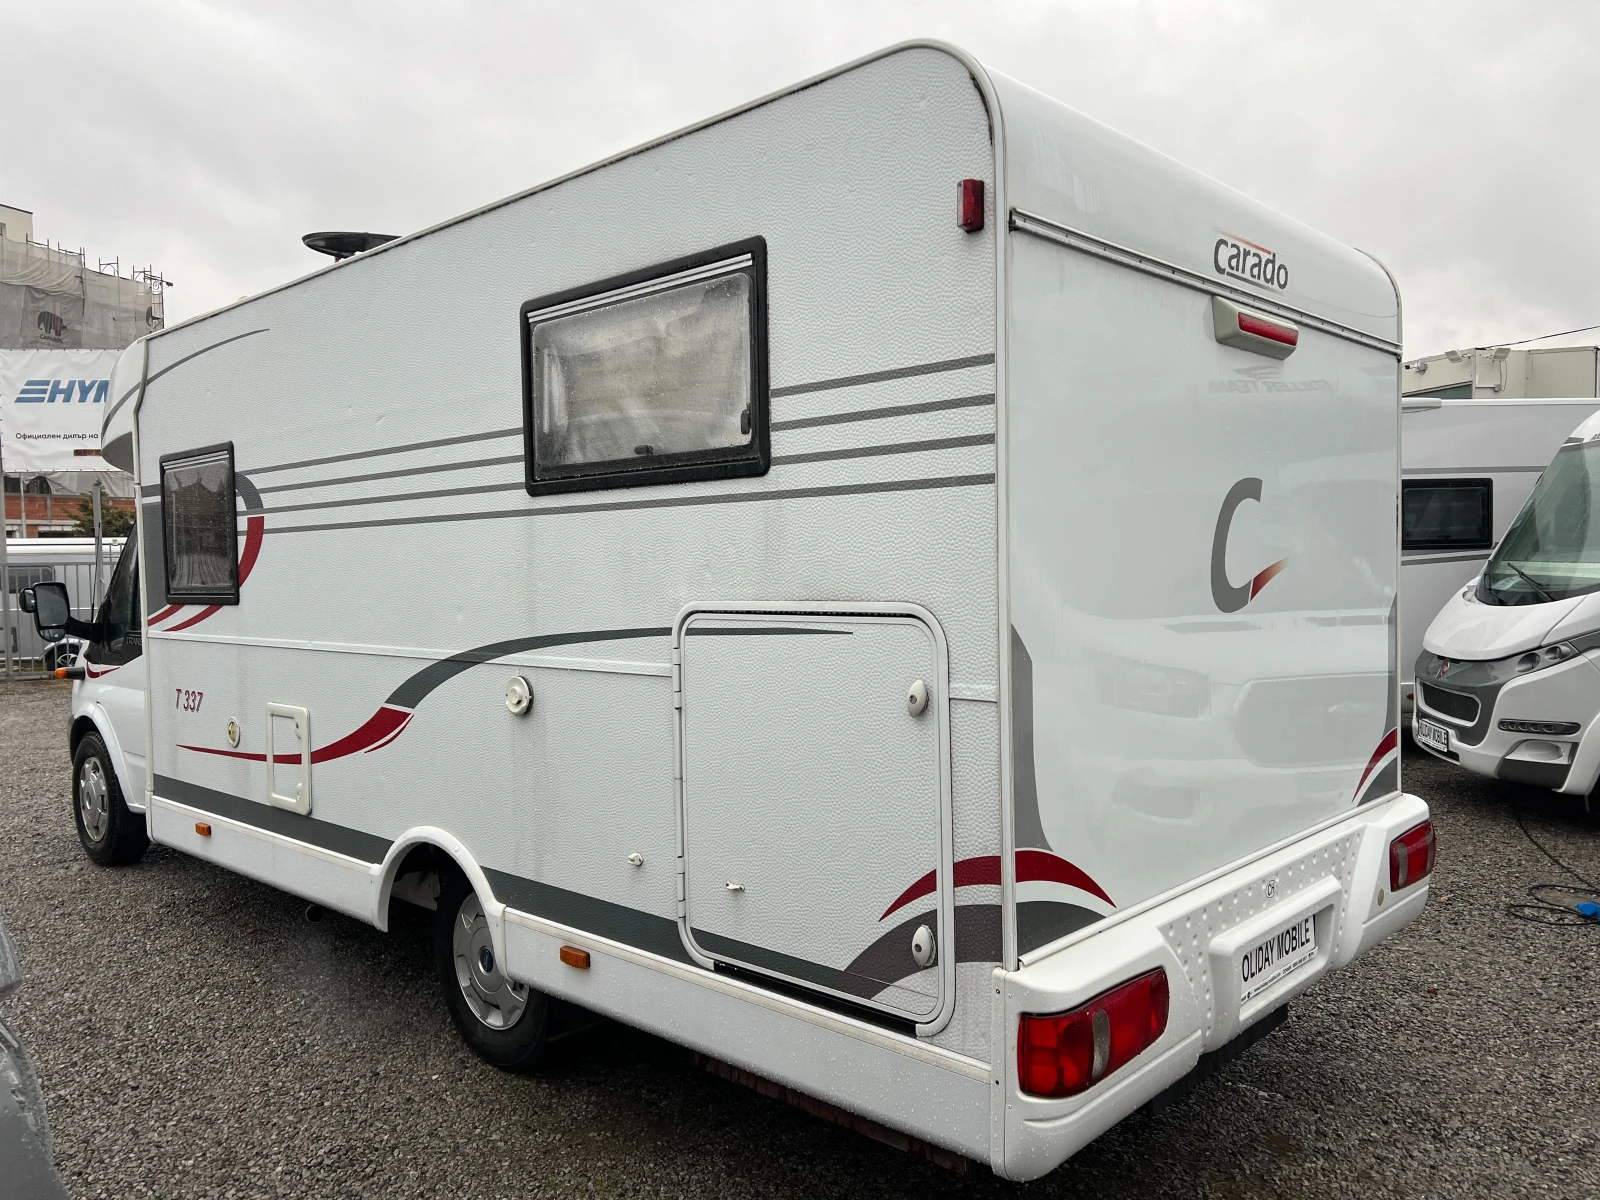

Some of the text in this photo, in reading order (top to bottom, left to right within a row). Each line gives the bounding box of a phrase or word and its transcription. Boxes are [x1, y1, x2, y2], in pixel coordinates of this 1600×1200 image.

[15, 432, 61, 440] Официален
[176, 689, 204, 713] T 337
[1242, 937, 1276, 982] OLIDAY
[1277, 918, 1310, 960] MOBILE
